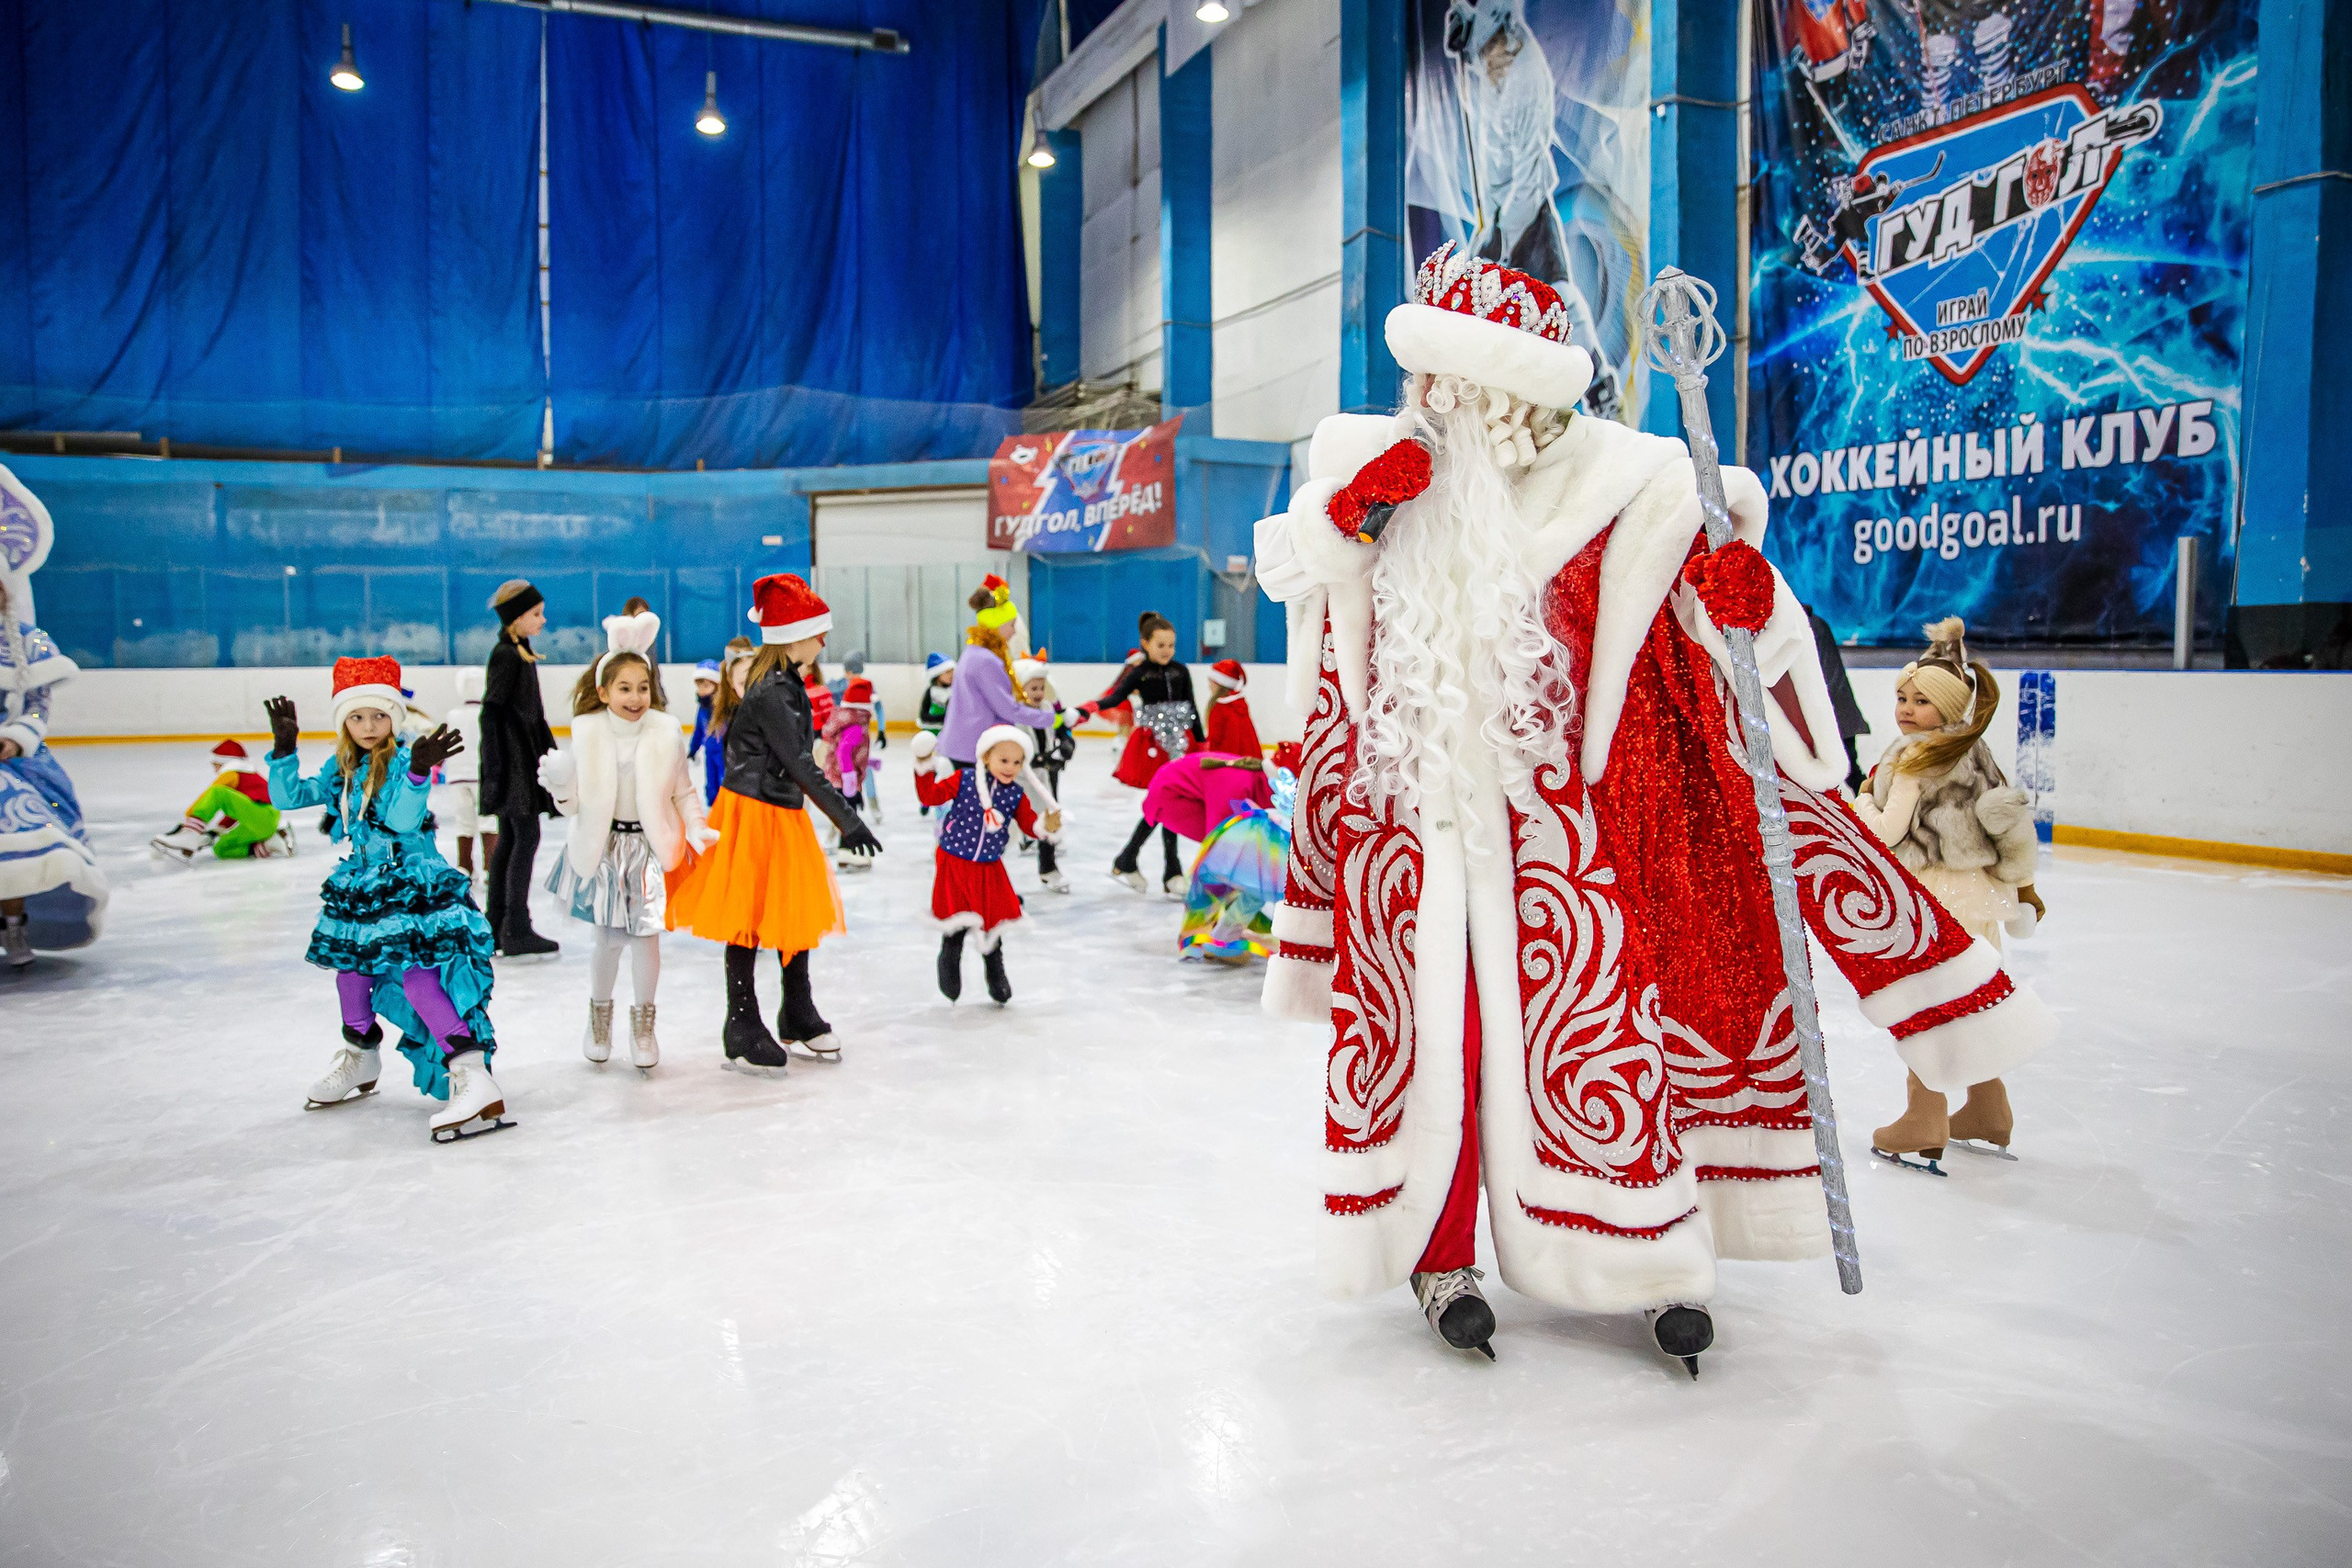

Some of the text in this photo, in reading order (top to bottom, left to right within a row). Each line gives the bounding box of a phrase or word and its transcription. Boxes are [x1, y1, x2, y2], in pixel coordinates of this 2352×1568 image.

[1877, 180, 1974, 276] ГУД
[1937, 288, 1988, 325] ИГРАЙ
[1903, 315, 2027, 359] ПО ВЗРОСЛОМУ
[1769, 400, 2217, 500] ХОККЕЙНЫЙ КЛУБ
[1082, 480, 1163, 528] ВПЕРЁД!
[1852, 494, 2082, 565] goodgoal.ru
